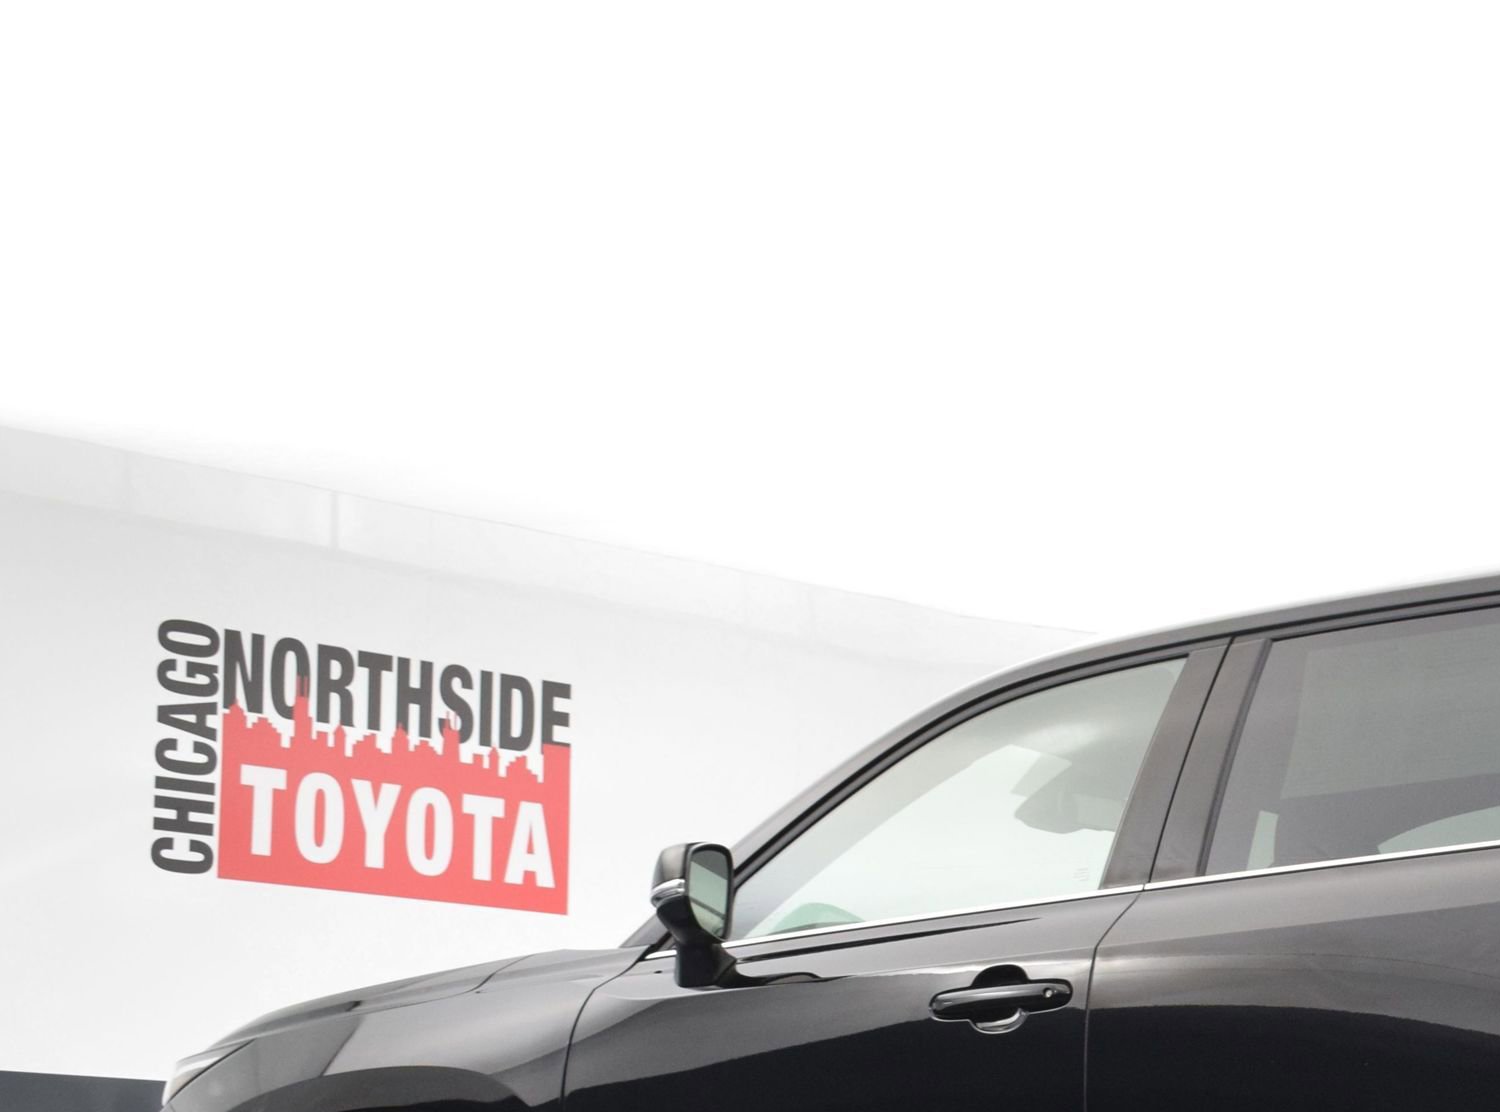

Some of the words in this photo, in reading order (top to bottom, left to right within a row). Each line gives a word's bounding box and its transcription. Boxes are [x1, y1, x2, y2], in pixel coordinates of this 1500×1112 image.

[151, 619, 220, 875] CHICAGO
[222, 628, 571, 752] NORTHSIDE
[240, 764, 556, 888] TOYOTA
